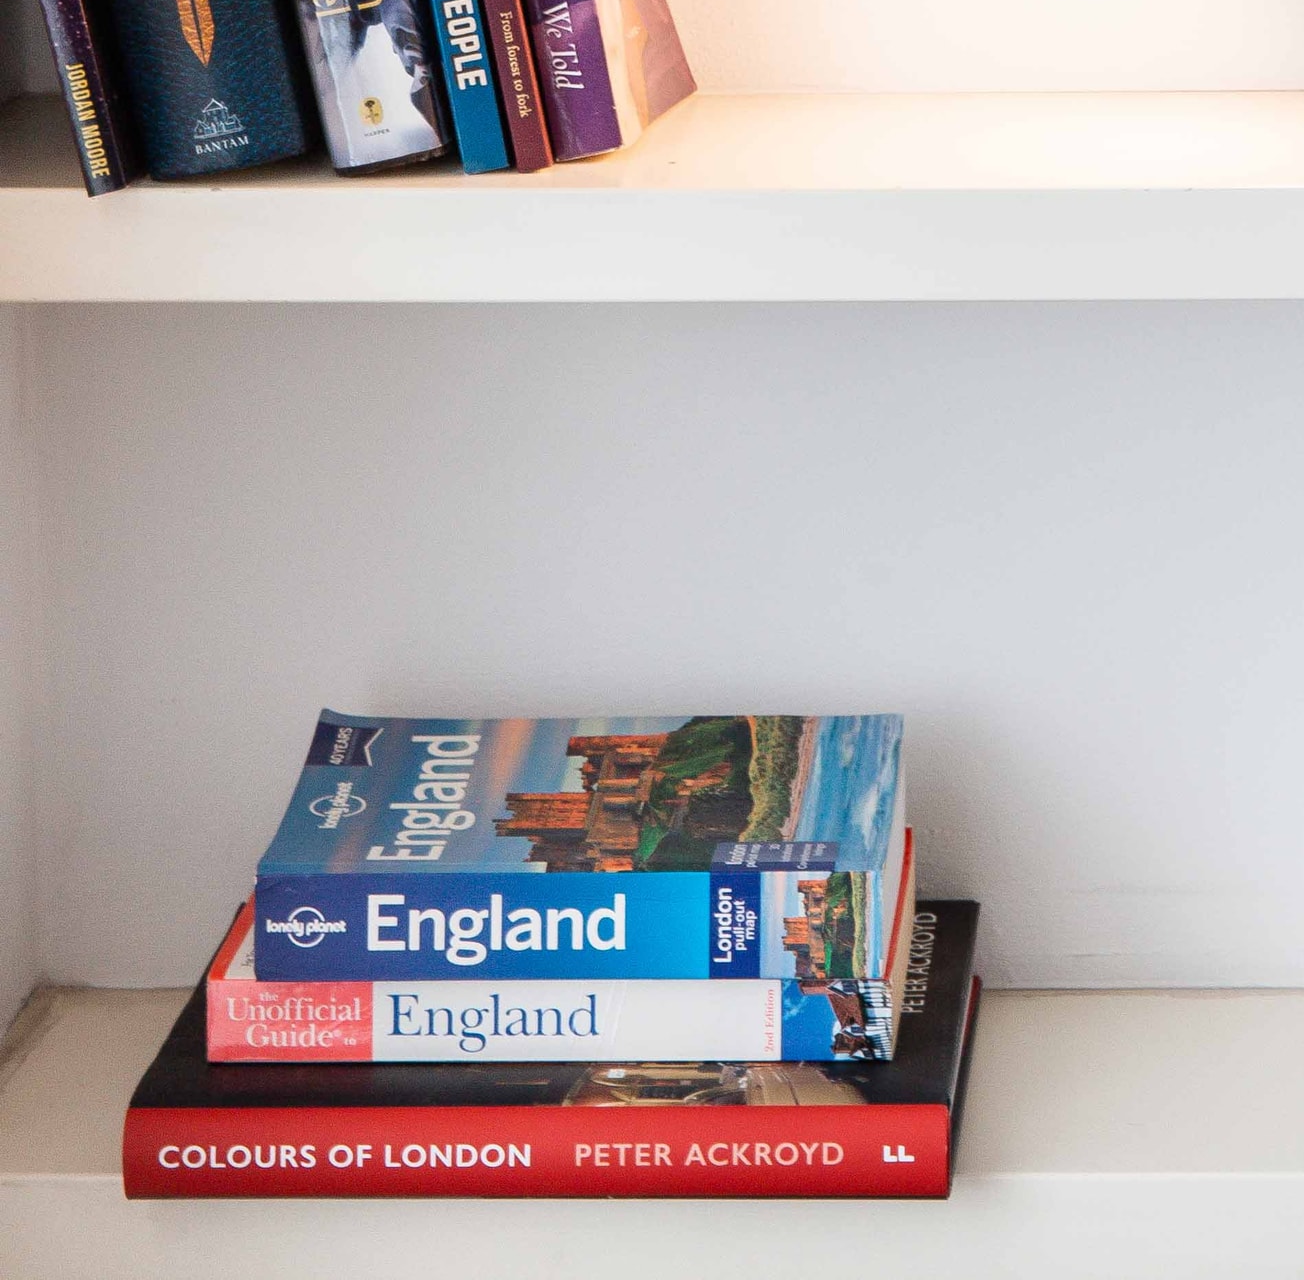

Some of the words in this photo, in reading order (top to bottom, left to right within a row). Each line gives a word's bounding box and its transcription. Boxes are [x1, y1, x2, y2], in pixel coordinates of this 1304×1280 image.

[498, 10, 515, 41] From
[543, 0, 573, 39] We
[504, 42, 523, 77] forest
[550, 42, 585, 91] Told
[65, 62, 95, 123] JORDAN
[513, 77, 524, 92] to
[515, 92, 531, 119] fork
[79, 122, 111, 178] MOORE
[194, 134, 250, 155] BANTAM
[332, 726, 353, 754] YEARS
[366, 734, 482, 862] England
[266, 918, 305, 936] lonely
[305, 918, 347, 936] planet
[367, 893, 627, 966] England
[713, 887, 733, 964] London
[734, 899, 746, 952] pull-out
[746, 910, 758, 941] map
[909, 912, 937, 973] ACKROYD
[226, 995, 362, 1022] Unofficial
[259, 991, 279, 1002] the
[765, 988, 775, 1028] Edition
[900, 974, 925, 1014] PETER
[386, 993, 600, 1053] England
[343, 1037, 357, 1046] to
[764, 1030, 775, 1054] 2nd
[157, 1144, 317, 1169] COLOURS
[327, 1144, 373, 1168] OF
[384, 1143, 532, 1169] LONDON
[575, 1143, 672, 1167] PETER
[684, 1142, 845, 1167] ACKROYD
